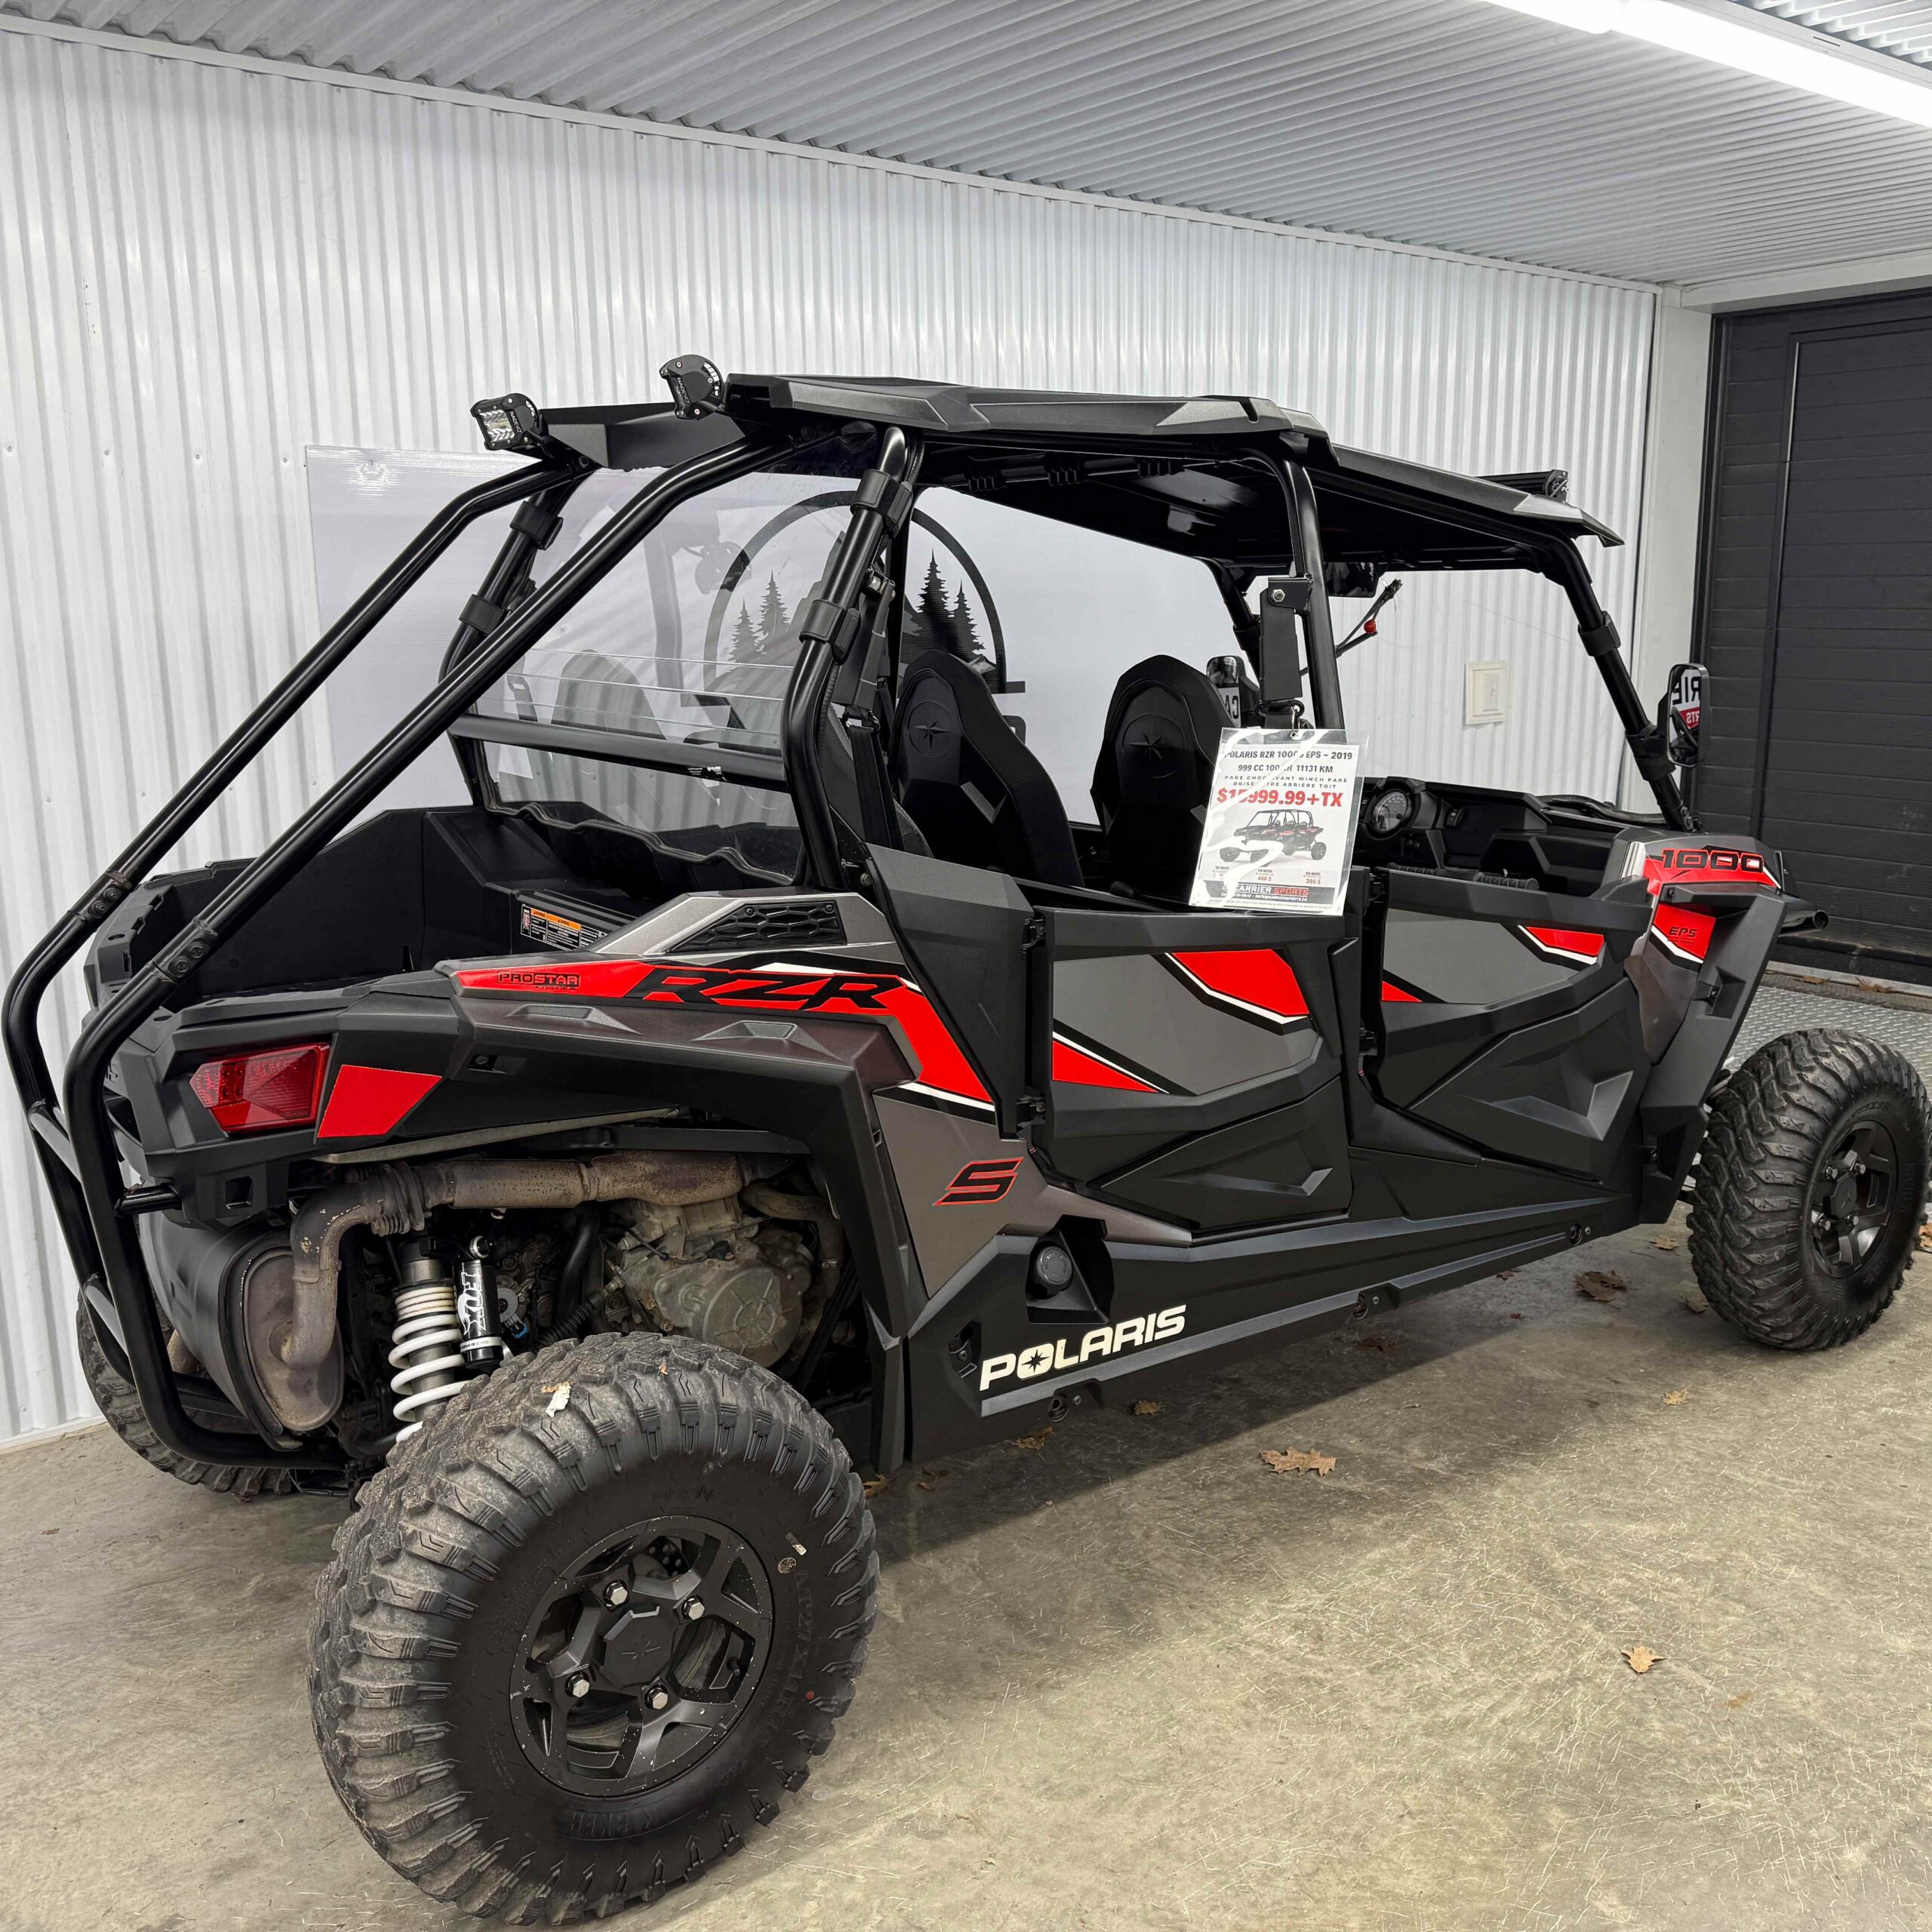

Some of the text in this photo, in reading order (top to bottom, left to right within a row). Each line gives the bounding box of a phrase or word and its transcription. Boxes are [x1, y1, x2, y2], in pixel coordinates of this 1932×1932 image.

[1331, 752, 1352, 760] 2019
[1662, 849, 1764, 872] 1000
[1273, 887, 1309, 896] SPORTS
[1669, 926, 1697, 937] EPS
[498, 972, 580, 986] PROSTAR
[634, 968, 904, 1010] RZR
[980, 1304, 1186, 1391] POLARIS
